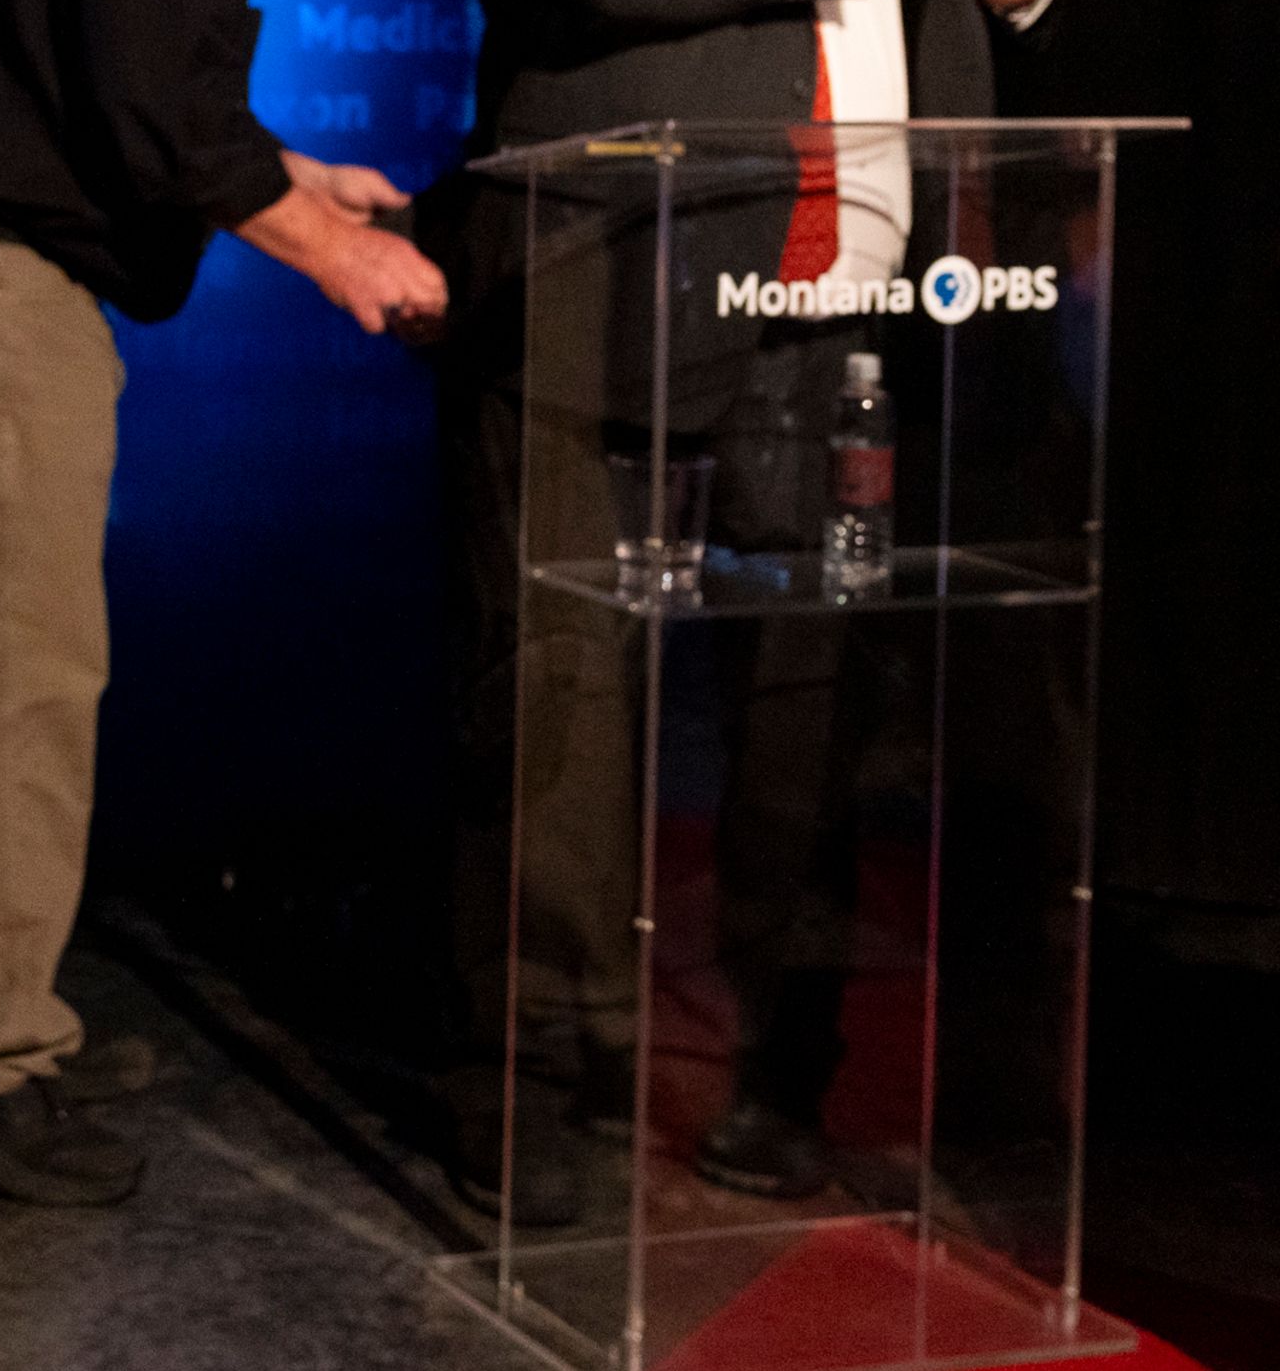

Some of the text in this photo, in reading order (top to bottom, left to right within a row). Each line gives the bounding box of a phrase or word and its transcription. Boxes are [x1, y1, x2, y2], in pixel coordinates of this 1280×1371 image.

[299, 3, 466, 55] Medic
[716, 265, 1059, 318] Montana PBS
